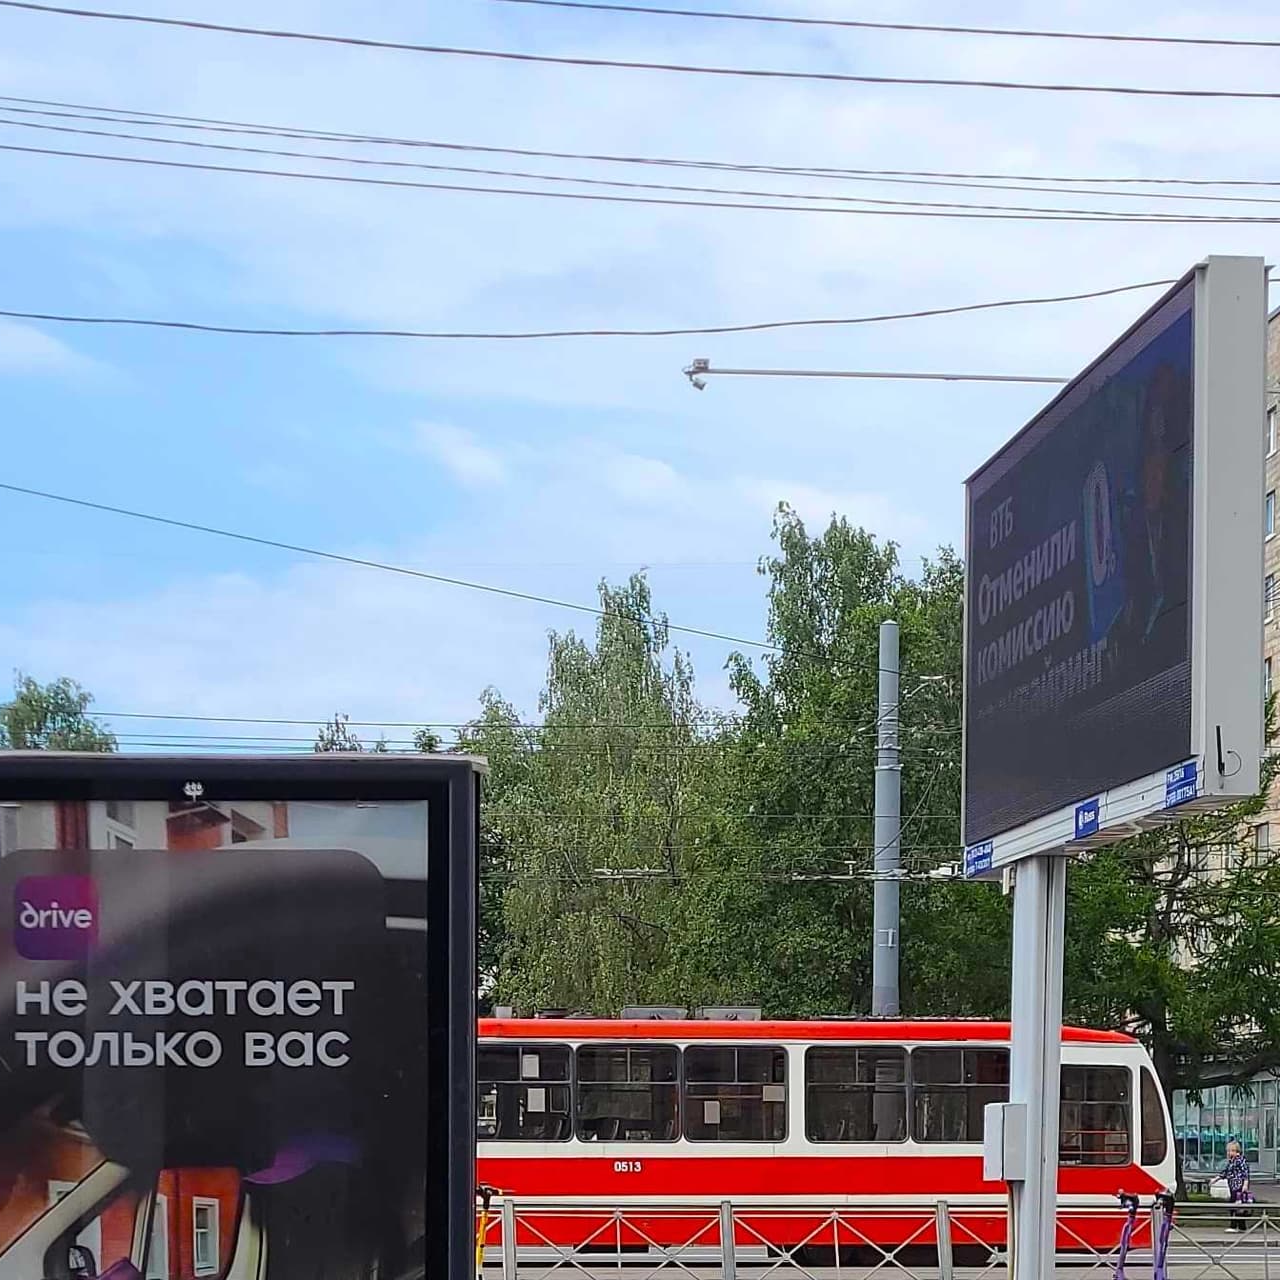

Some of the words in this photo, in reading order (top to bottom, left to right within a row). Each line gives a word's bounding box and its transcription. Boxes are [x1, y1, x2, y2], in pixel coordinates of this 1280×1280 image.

[990, 497, 1013, 549] ВТБ
[978, 520, 1077, 626] Отменили
[977, 591, 1075, 686] комиссию
[20, 901, 93, 930] drive
[15, 980, 87, 1016] не
[109, 980, 355, 1017] хватает
[15, 1031, 222, 1067] только
[245, 1031, 351, 1067] вас
[614, 1161, 642, 1172] 0513
